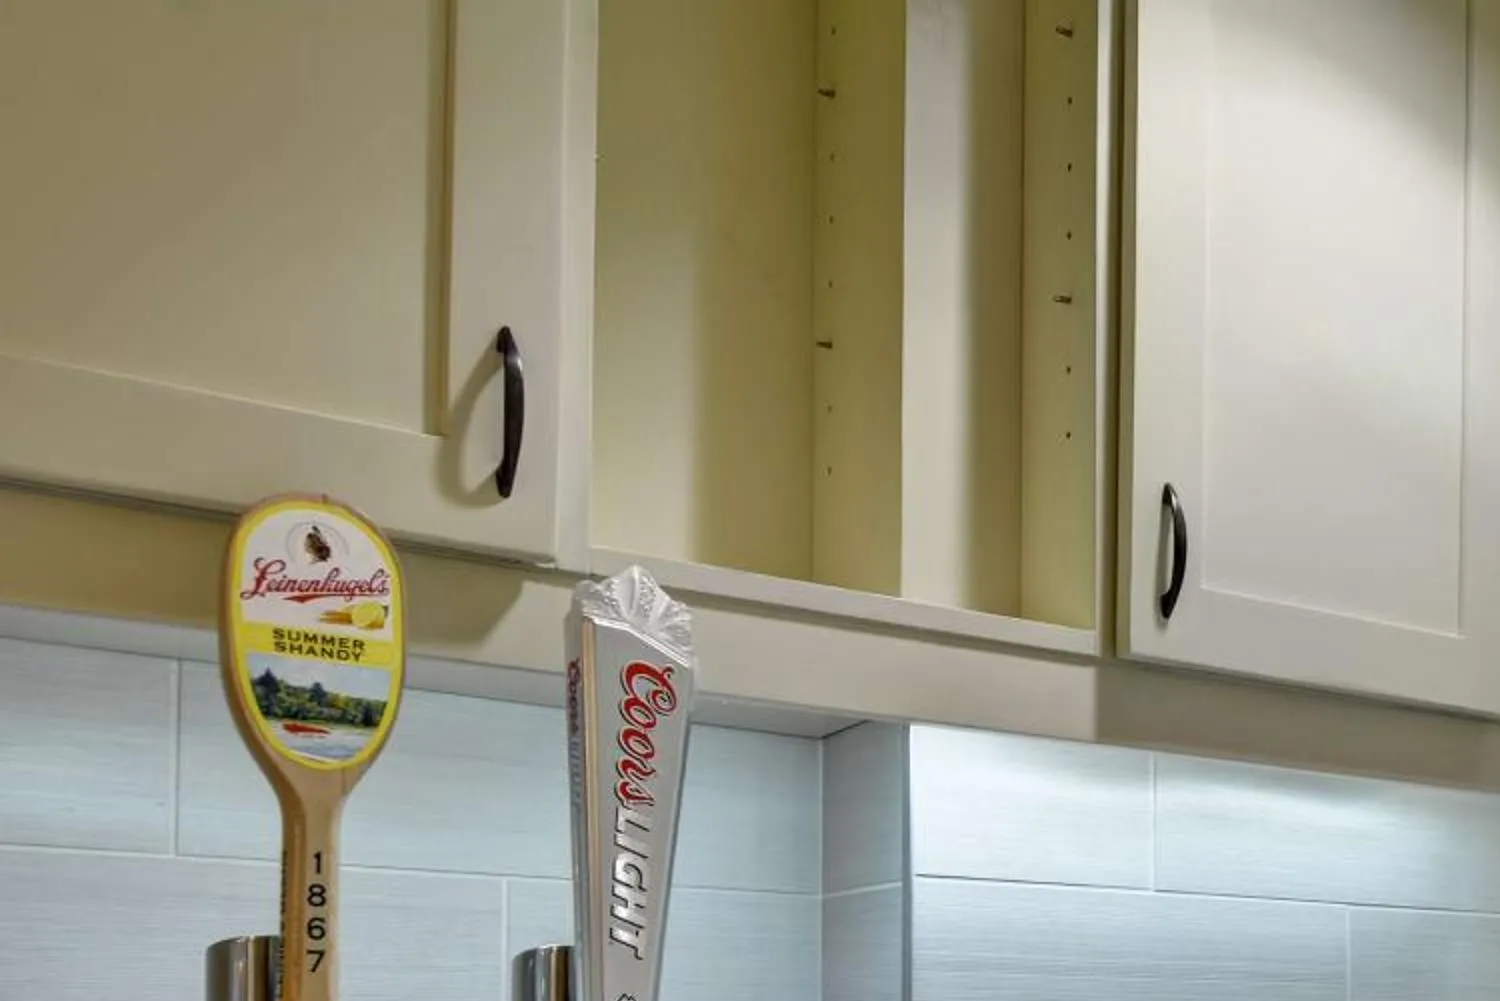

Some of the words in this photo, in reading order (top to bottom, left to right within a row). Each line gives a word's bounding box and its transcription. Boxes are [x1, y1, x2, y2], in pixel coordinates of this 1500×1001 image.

[240, 557, 391, 601] Leinenkugel's
[272, 627, 366, 651] SUMMER
[273, 641, 363, 663] SHANDY
[615, 661, 677, 808] Coors
[306, 852, 327, 973] 1867
[609, 804, 651, 961] LIGHT
